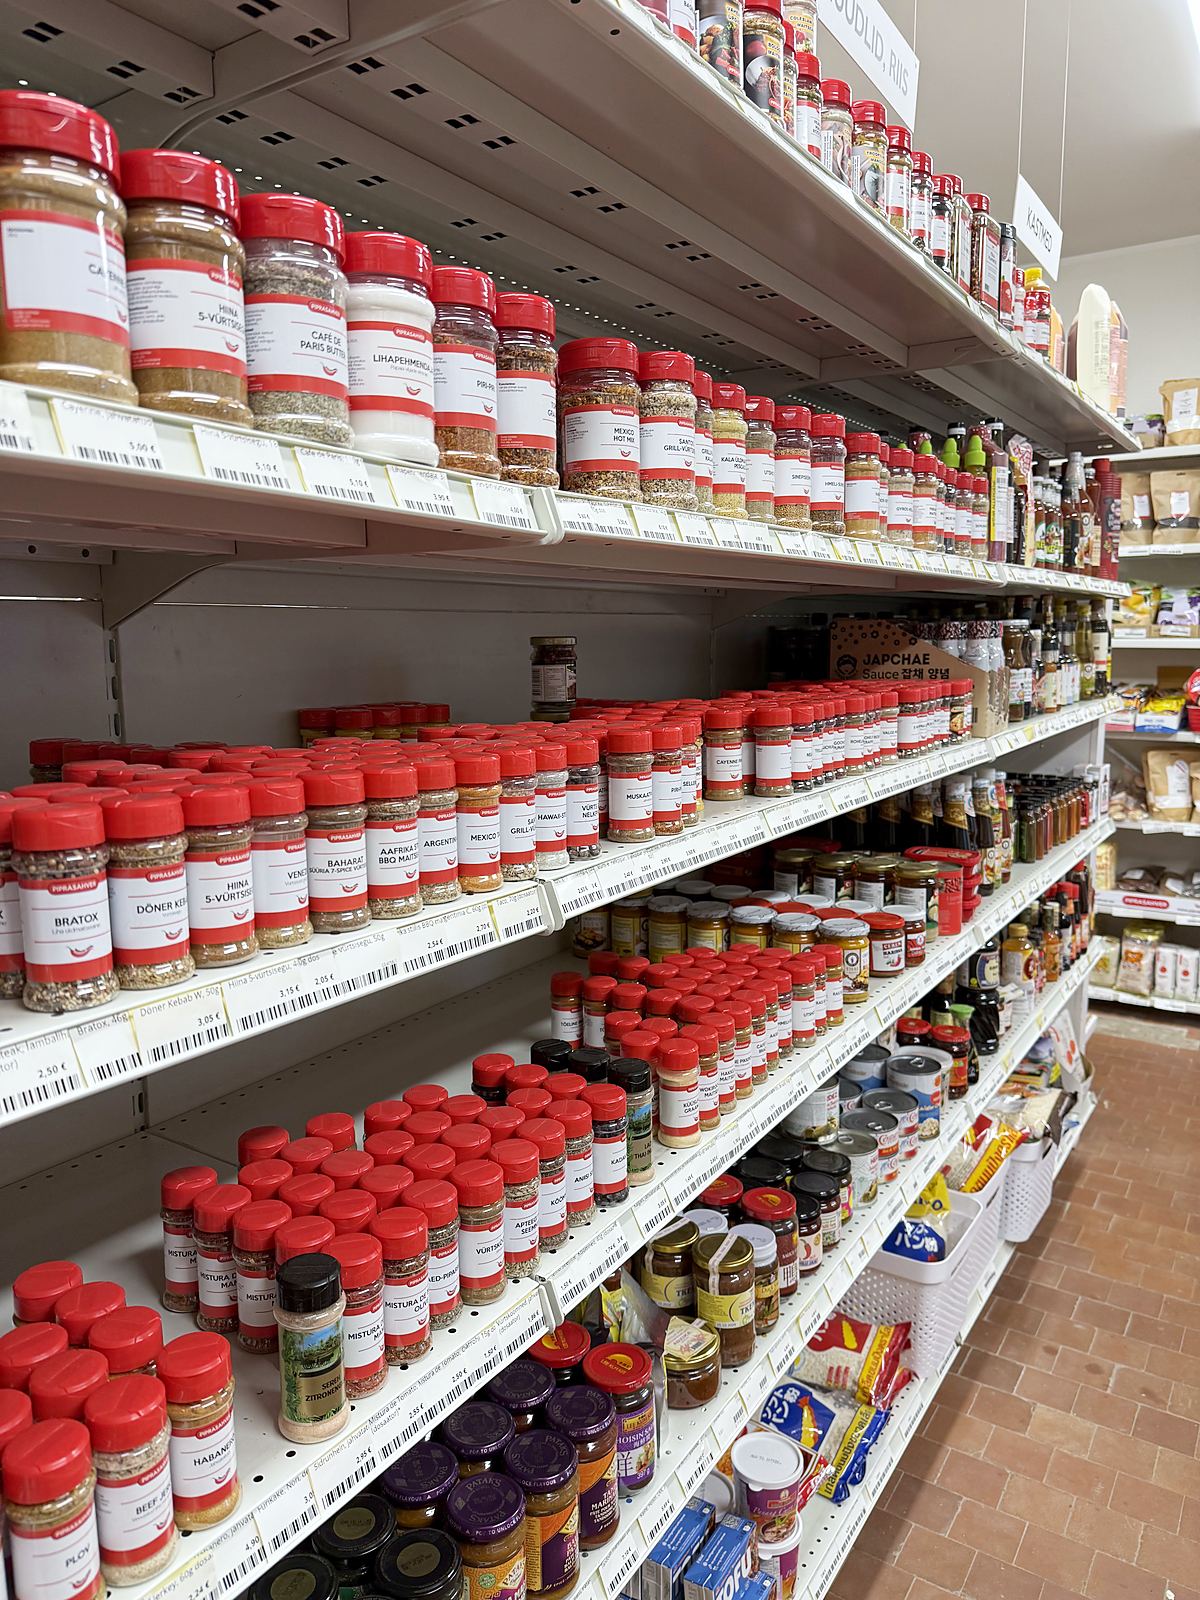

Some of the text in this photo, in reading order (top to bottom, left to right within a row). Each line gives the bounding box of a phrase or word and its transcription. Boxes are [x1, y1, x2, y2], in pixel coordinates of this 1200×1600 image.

[889, 48, 909, 97] RIIS
[1027, 206, 1053, 253] KASTMED
[218, 304, 239, 319] HIINA
[311, 330, 342, 347] CAFÉ DE
[300, 340, 325, 352] PARIS
[613, 427, 634, 436] MEXICO
[613, 435, 635, 444] HOT MIX
[255, 462, 279, 473] 5,10 €
[349, 478, 370, 488] 5,10 €
[520, 507, 524, 515] €
[862, 652, 931, 667] JAPCHAE
[862, 668, 900, 680] Sauce
[902, 667, 950, 680] 잡채 양념
[470, 833, 497, 842] MEXICO
[380, 845, 414, 856] AAFRIKA
[327, 855, 365, 868] BAHARAT
[378, 856, 397, 865] BBQ
[330, 865, 352, 874] 7-SPICE
[52, 880, 97, 893] PIPRASAHVER
[226, 879, 250, 892] HIINA
[136, 901, 174, 916] DÖNER
[54, 912, 100, 928] BRATOX
[476, 922, 491, 932] 2,70 €
[372, 933, 386, 944] 50g
[427, 938, 444, 950] 2,54 €
[228, 977, 248, 990] Hiina
[314, 973, 335, 985] 2,05 €
[279, 984, 301, 998] 3,15 €
[167, 994, 193, 1011] Kebab
[194, 990, 205, 1004] W,
[205, 985, 220, 1001] 50g
[76, 1012, 129, 1037] Bratox, 46g
[197, 1012, 222, 1027] 3,05 €
[38, 1062, 69, 1079] 2,50 €
[634, 1151, 646, 1160] THAI
[168, 1249, 198, 1257] MISTURA
[200, 1272, 230, 1282] MISTURA
[384, 1293, 427, 1310] MISTURA DE
[348, 1326, 381, 1341] MISTURA
[483, 1348, 494, 1359] 1,50
[451, 1367, 468, 1383] 2,50 €
[368, 1386, 418, 1427] Mistura de Tomato,
[408, 1402, 425, 1419] 2,55 €
[626, 1421, 636, 1430] LEE
[313, 1445, 347, 1472] Sidrunhein,
[356, 1450, 368, 1464] 2,95
[135, 1496, 160, 1516] BEEF
[497, 1519, 516, 1534] UNLOCK
[244, 1535, 260, 1551] 4,90
[65, 1544, 92, 1568] PLOV
[179, 1567, 195, 1581] 60g
[204, 1579, 211, 1589] €
